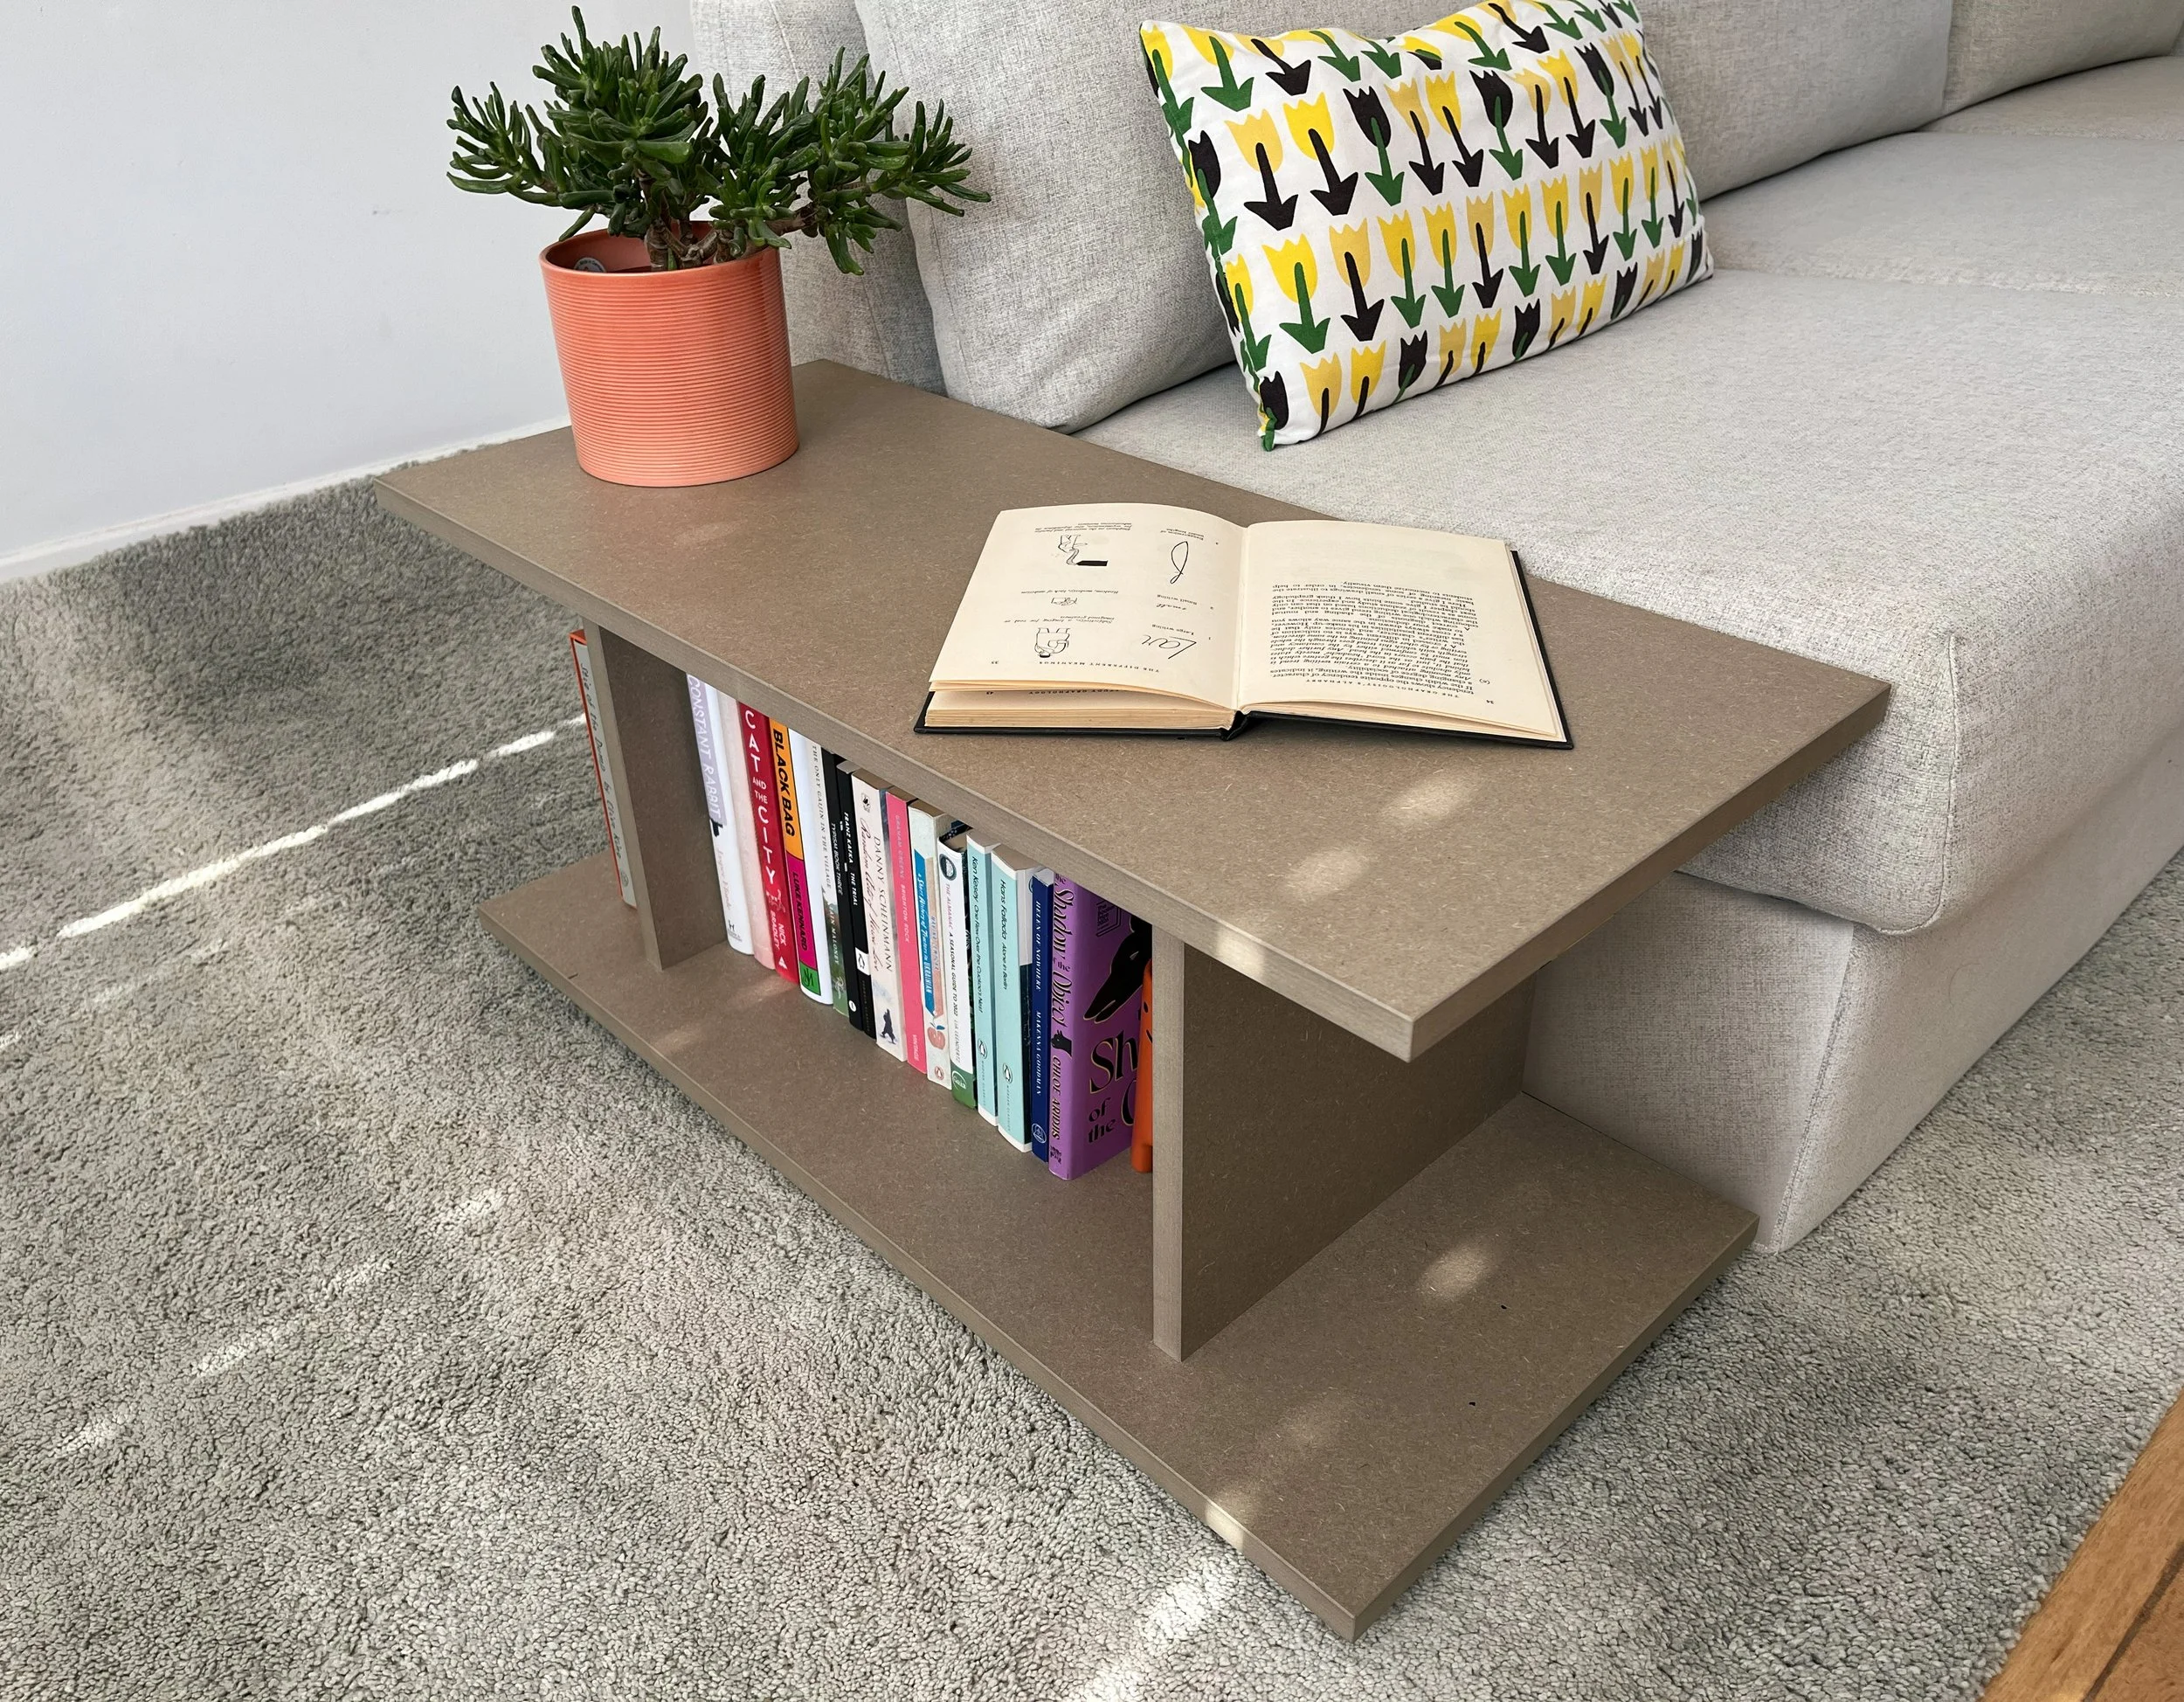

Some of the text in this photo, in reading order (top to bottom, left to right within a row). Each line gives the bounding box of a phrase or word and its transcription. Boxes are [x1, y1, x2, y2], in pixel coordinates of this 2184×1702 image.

[585, 694, 596, 709] of
[1357, 681, 1438, 695] GRAPHOLOGIST'S
[589, 712, 599, 731] the
[686, 674, 722, 819] CONSTANT RABBIT
[602, 781, 612, 793] by
[771, 728, 795, 837] BLACK BAG
[812, 765, 821, 787] ONLY
[744, 709, 777, 886] CAT AND THE CITY
[815, 790, 825, 820] GAIJIN
[605, 799, 619, 829] Clive
[819, 822, 826, 833] IN
[842, 812, 851, 838] FRANZ
[819, 834, 828, 853] THE
[859, 817, 874, 868] Random
[894, 814, 903, 848] GRAHAM
[822, 854, 832, 889] VILLAGE
[828, 822, 844, 896] TYPISM BOOK THREE
[896, 850, 905, 880] GREENE
[916, 876, 925, 896] Short
[971, 875, 979, 902] Kesey
[791, 871, 808, 951] LUKE KENNARD
[863, 896, 878, 912] of
[873, 835, 893, 972] DANNY SCHEINMANN
[899, 883, 909, 922] BRIGHTON
[917, 895, 927, 919] History
[945, 896, 954, 930] ALMANAC
[999, 879, 1009, 940] Hans Fallada
[768, 909, 781, 950] BRADLEY
[777, 922, 787, 945] NICK
[1052, 888, 1075, 958] Shadow
[829, 926, 840, 965] MALONEY
[920, 929, 930, 954] Tractors
[948, 938, 957, 971] SEASONAL
[1034, 935, 1041, 948] OF
[871, 945, 881, 971] Love
[1057, 960, 1071, 972] the
[923, 960, 932, 993] UKRAINIAN
[951, 993, 957, 1001] TO
[1050, 971, 1073, 1028] Object
[1051, 1055, 1062, 1095] CHLOE
[1050, 1097, 1061, 1139] ARIDJIS
[1089, 1097, 1111, 1124] of
[1089, 1117, 1116, 1144] the
